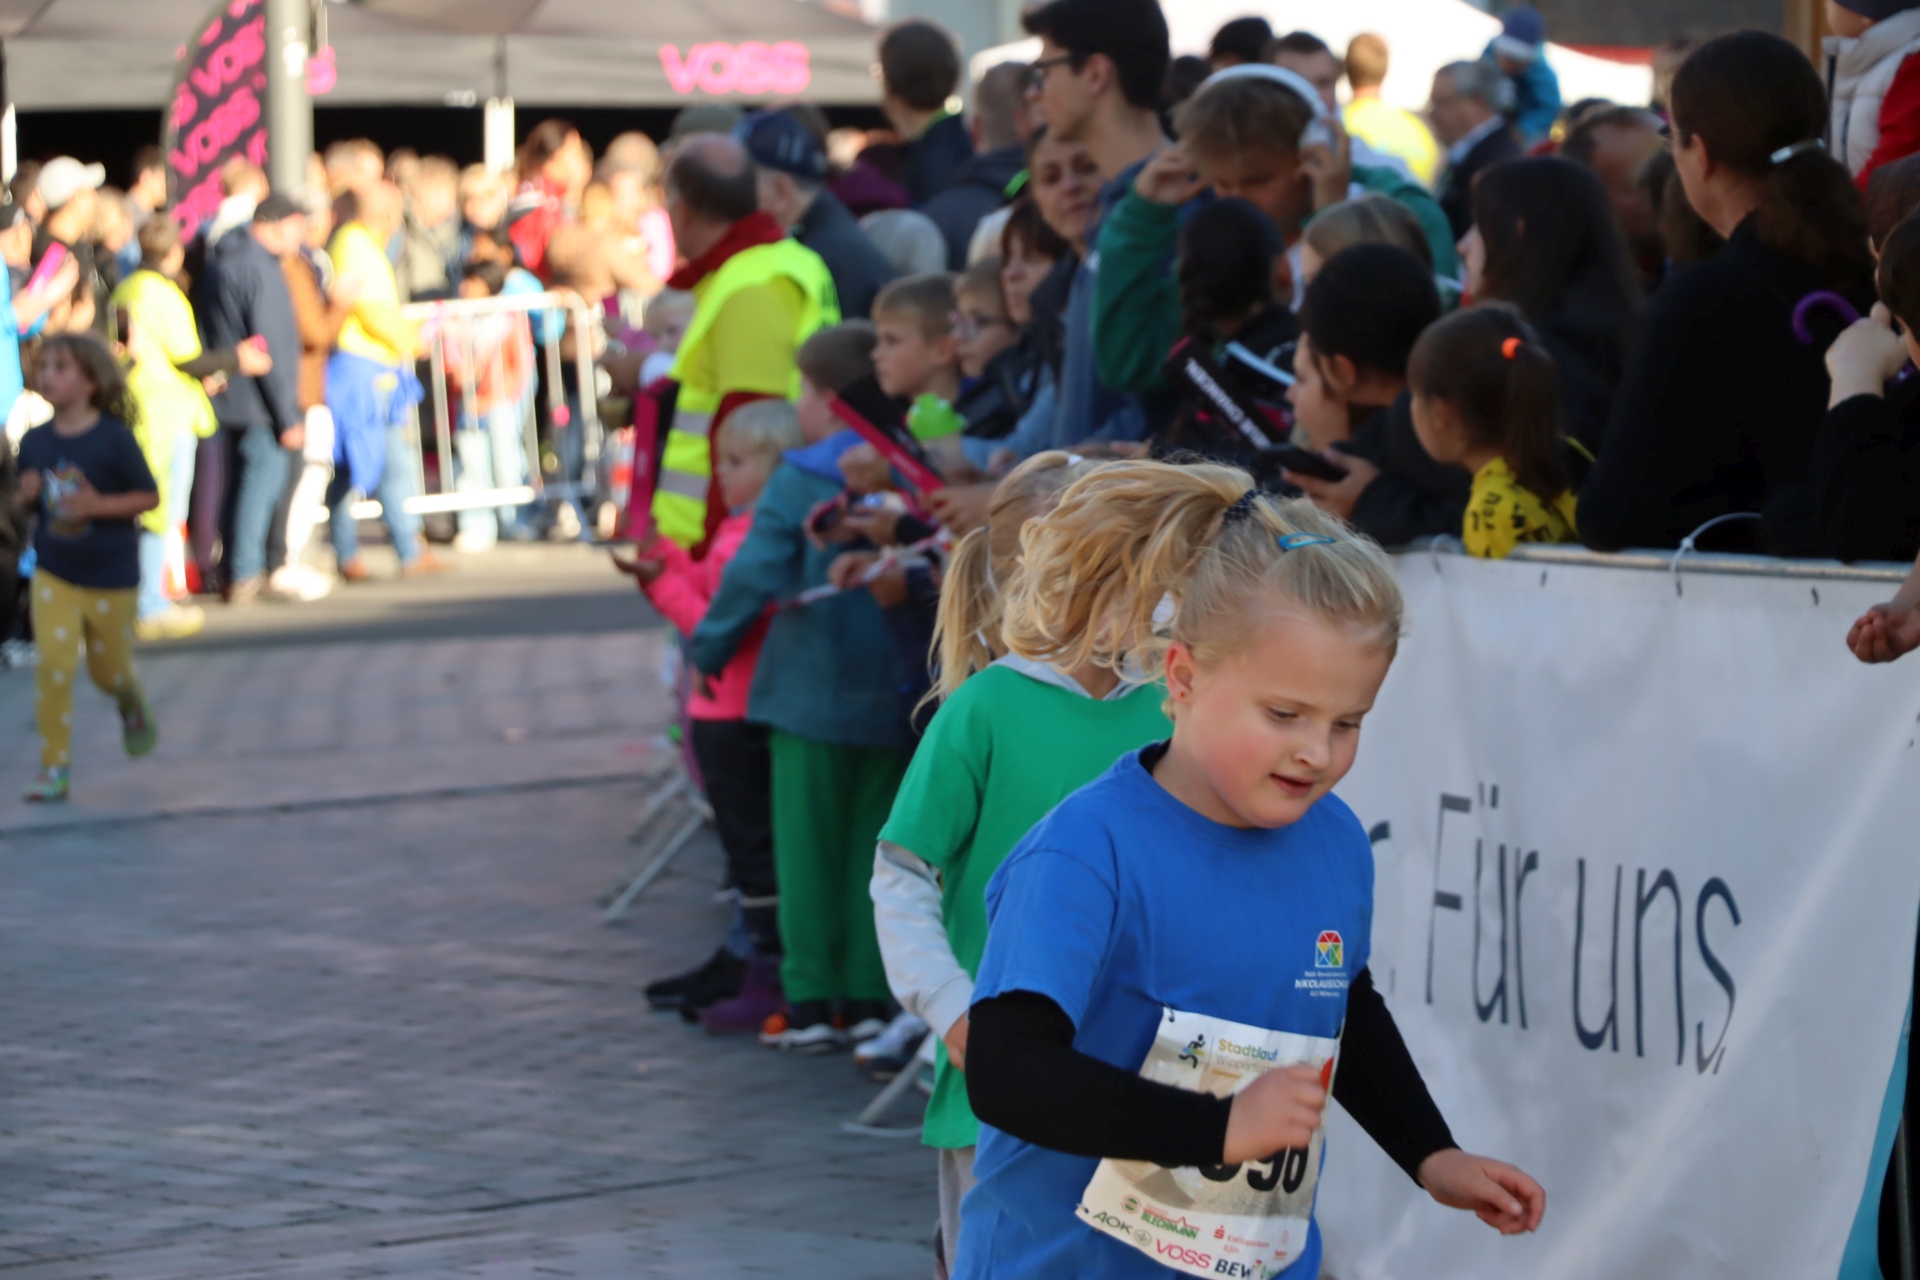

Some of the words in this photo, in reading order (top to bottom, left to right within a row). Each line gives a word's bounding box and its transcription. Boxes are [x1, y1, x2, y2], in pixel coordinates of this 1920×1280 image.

[659, 40, 811, 95] VOSS
[167, 86, 261, 179] VOSS
[1425, 781, 1540, 1030] Für
[1217, 1038, 1279, 1062] Stadtlauf
[1092, 1211, 1133, 1236] AOK
[1141, 1211, 1199, 1240] BLECHMANN
[1155, 1238, 1212, 1270] VOSS
